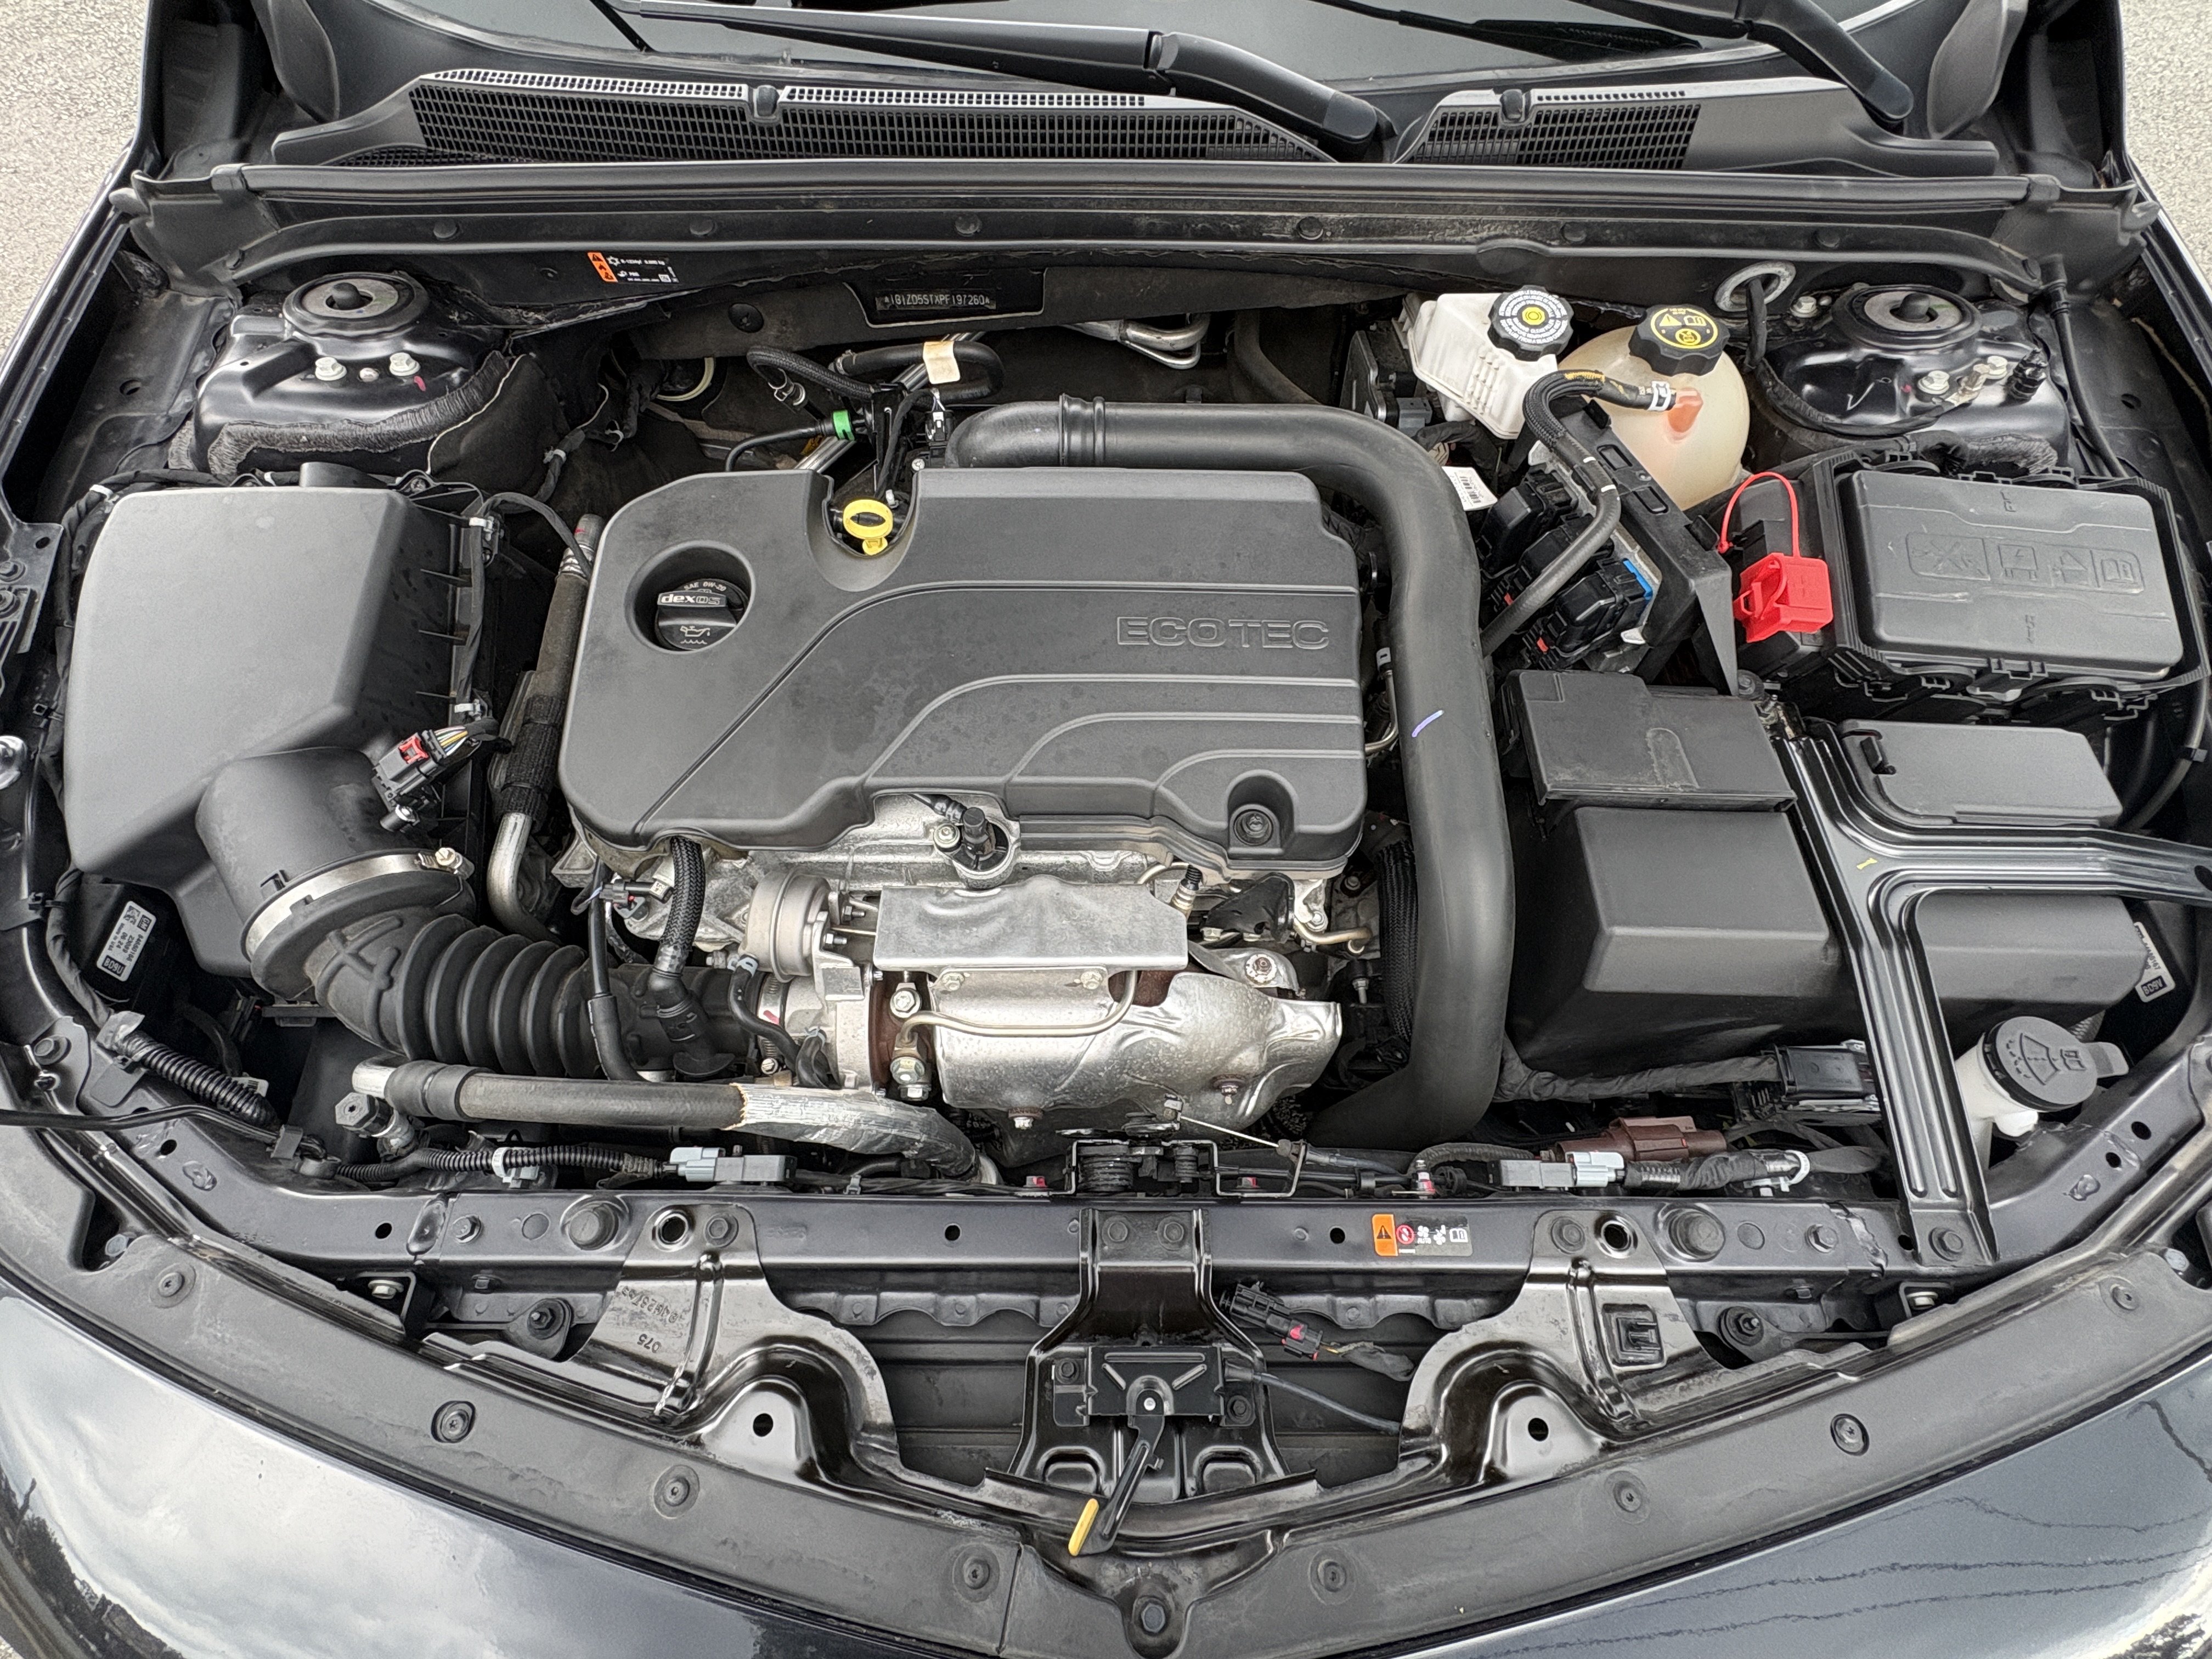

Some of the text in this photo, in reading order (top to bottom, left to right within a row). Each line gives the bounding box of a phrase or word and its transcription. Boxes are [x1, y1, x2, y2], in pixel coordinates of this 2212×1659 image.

[661, 594, 721, 605] dexos
[1117, 616, 1330, 650] ECOTEC
[637, 1333, 662, 1353] 075
